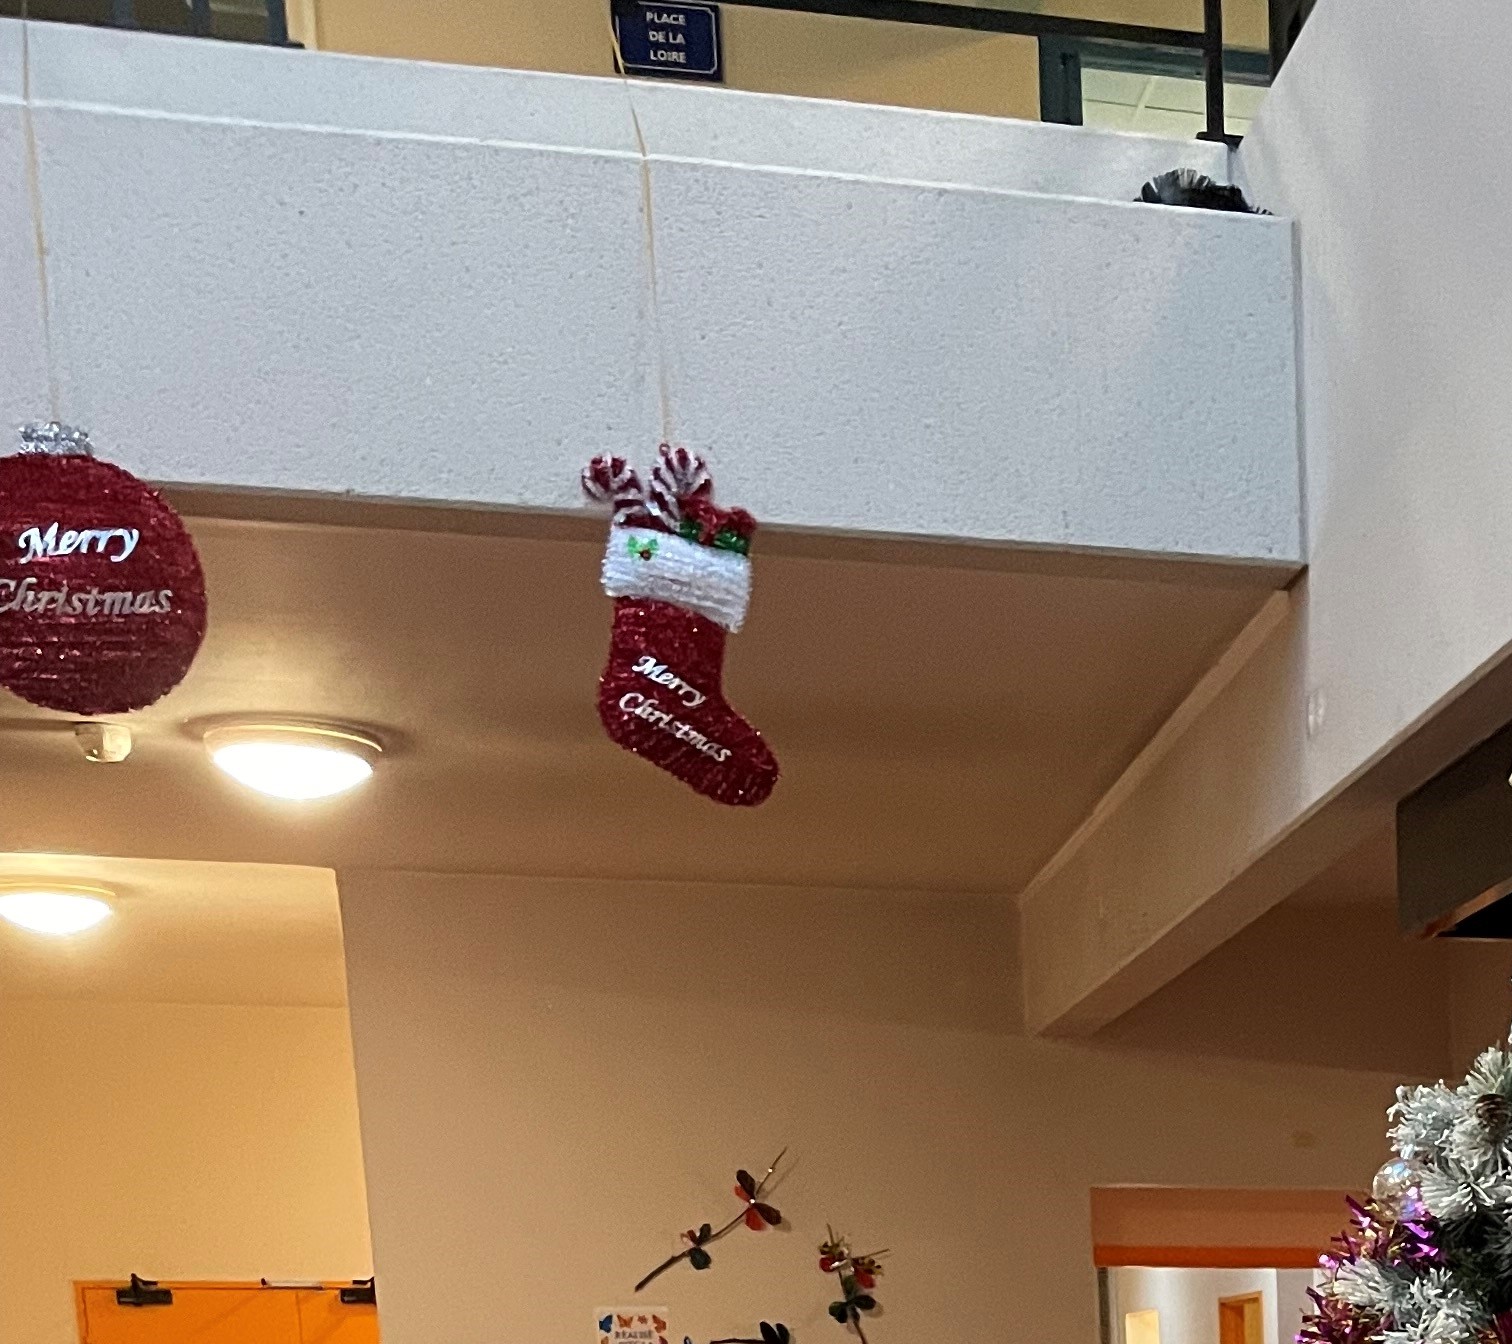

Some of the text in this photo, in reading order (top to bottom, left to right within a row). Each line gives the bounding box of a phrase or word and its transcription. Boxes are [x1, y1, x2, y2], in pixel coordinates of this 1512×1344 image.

[646, 11, 686, 27] PLACE
[649, 30, 686, 46] DE LA
[650, 50, 687, 64] LOIRE
[18, 521, 140, 565] Merry
[631, 655, 707, 708] Merry
[619, 692, 733, 762] Christmas
